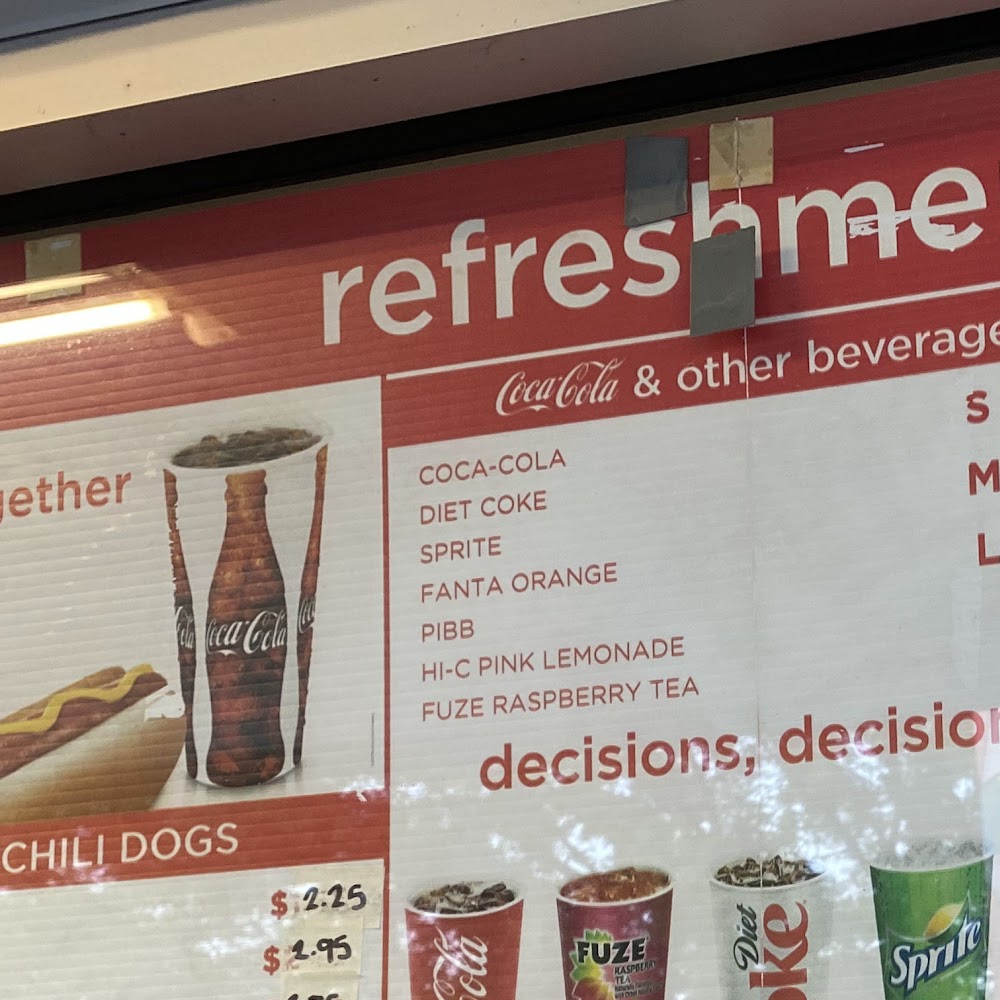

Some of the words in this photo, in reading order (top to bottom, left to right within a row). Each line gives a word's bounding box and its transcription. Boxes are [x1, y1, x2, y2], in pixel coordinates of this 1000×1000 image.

[495, 358, 624, 416] Coca-Cola
[633, 364, 661, 398] &
[677, 351, 791, 393] other
[966, 389, 990, 424] S
[419, 449, 566, 485] COCA-COLA
[968, 459, 1000, 495] M
[0, 469, 132, 524] ether
[420, 500, 472, 525] DIET
[480, 490, 547, 517] COKE
[420, 536, 502, 564] SPRITE
[977, 532, 1000, 566] L
[421, 576, 503, 603] FANTA
[511, 562, 618, 593] ORANGE
[421, 619, 475, 643] PIBB
[422, 658, 470, 682] HI-C
[479, 652, 535, 677] PINK
[543, 636, 685, 670] LEMONADE
[422, 697, 485, 722] FUZE
[493, 682, 642, 715] RASPBERRY
[648, 676, 700, 700] TEA
[479, 731, 757, 792] decisions,
[1, 834, 105, 874] CHILI
[120, 822, 239, 864] DOGS
[576, 937, 647, 965] FUZE
[733, 903, 760, 971] Diet
[890, 914, 984, 992] Sprite
